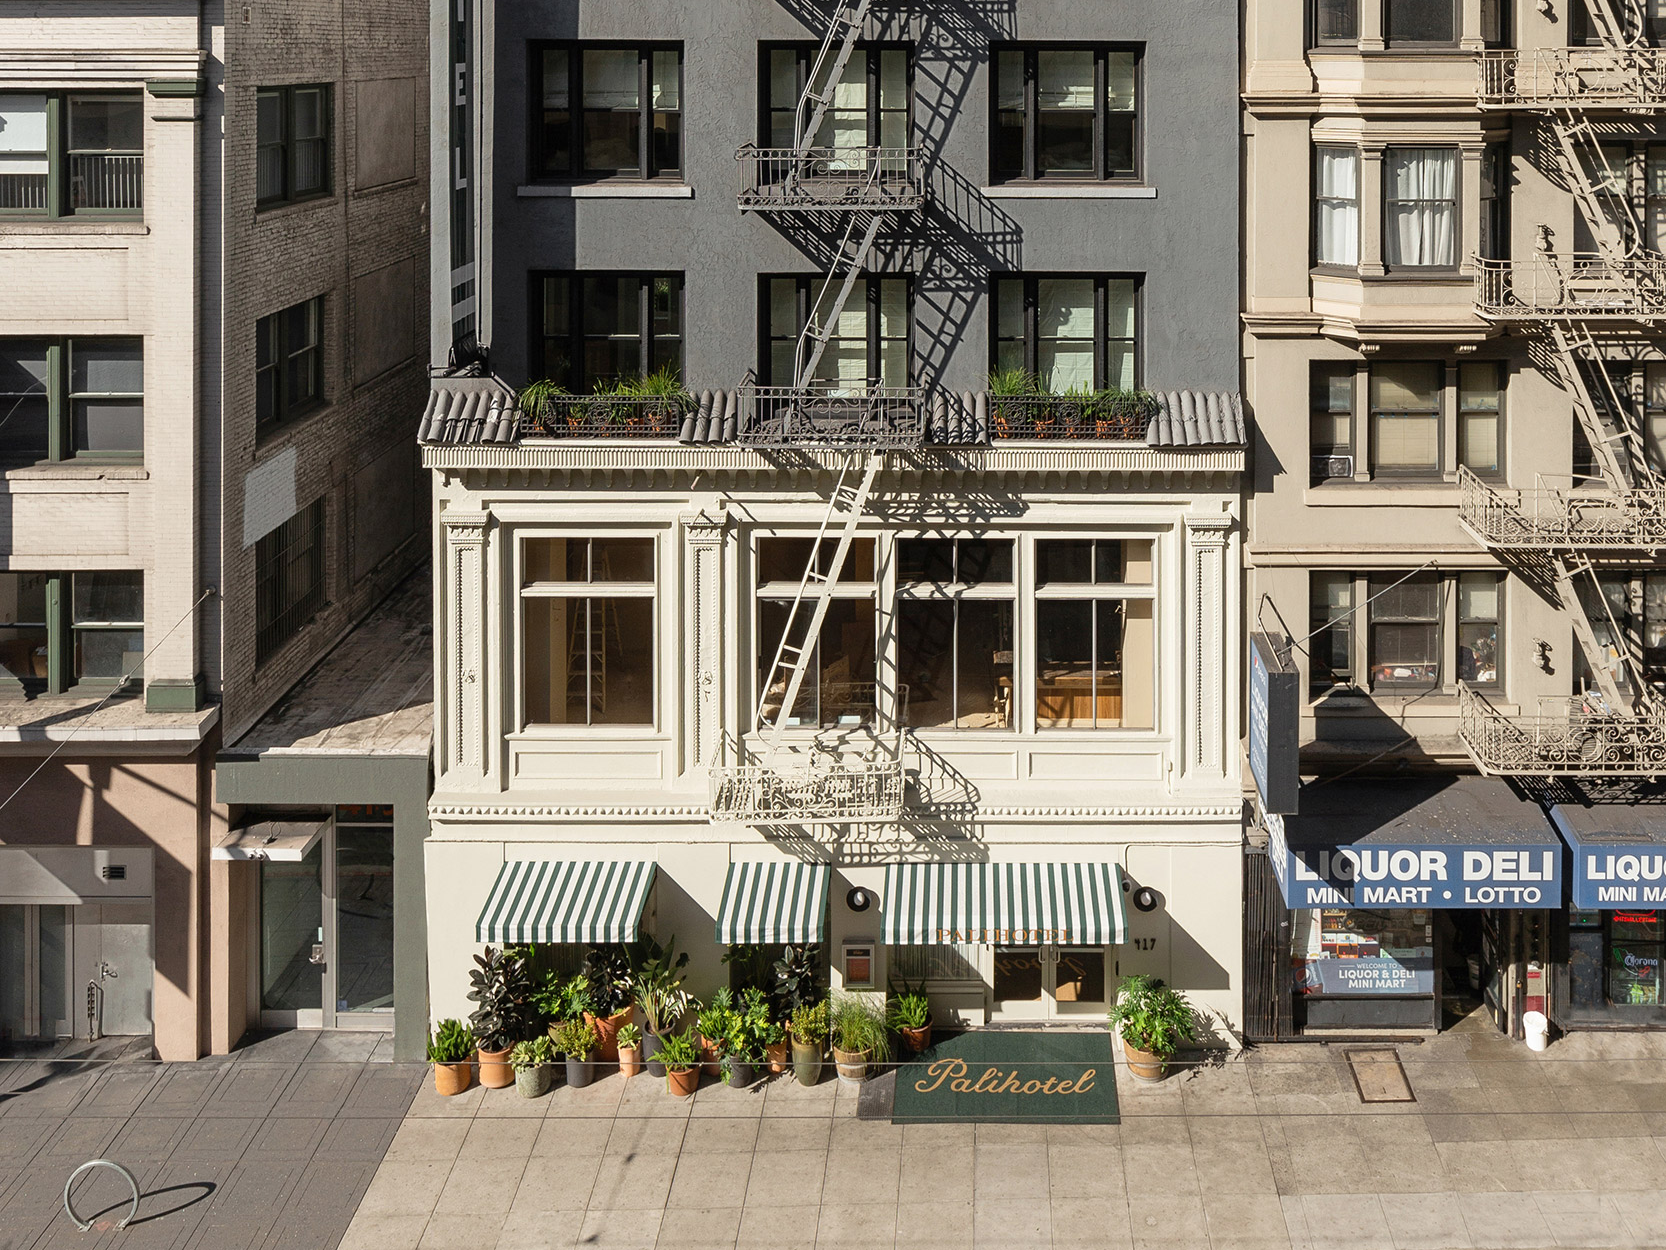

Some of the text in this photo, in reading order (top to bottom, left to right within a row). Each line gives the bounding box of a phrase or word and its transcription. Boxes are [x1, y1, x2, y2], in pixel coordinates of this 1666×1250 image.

[1295, 849, 1553, 883] LIQUOR DELI
[1587, 854, 1666, 882] LIQU
[1307, 886, 1541, 904] MINI MART LOTTO
[1598, 886, 1637, 902] MINI
[936, 929, 1074, 942] PALIHOTEL
[1134, 938, 1156, 950] 417
[1624, 955, 1658, 967] Corona
[1338, 970, 1416, 979] LIQUOR & DELI
[1348, 979, 1406, 989] MINI MART
[914, 1058, 1097, 1095] Palihotel
